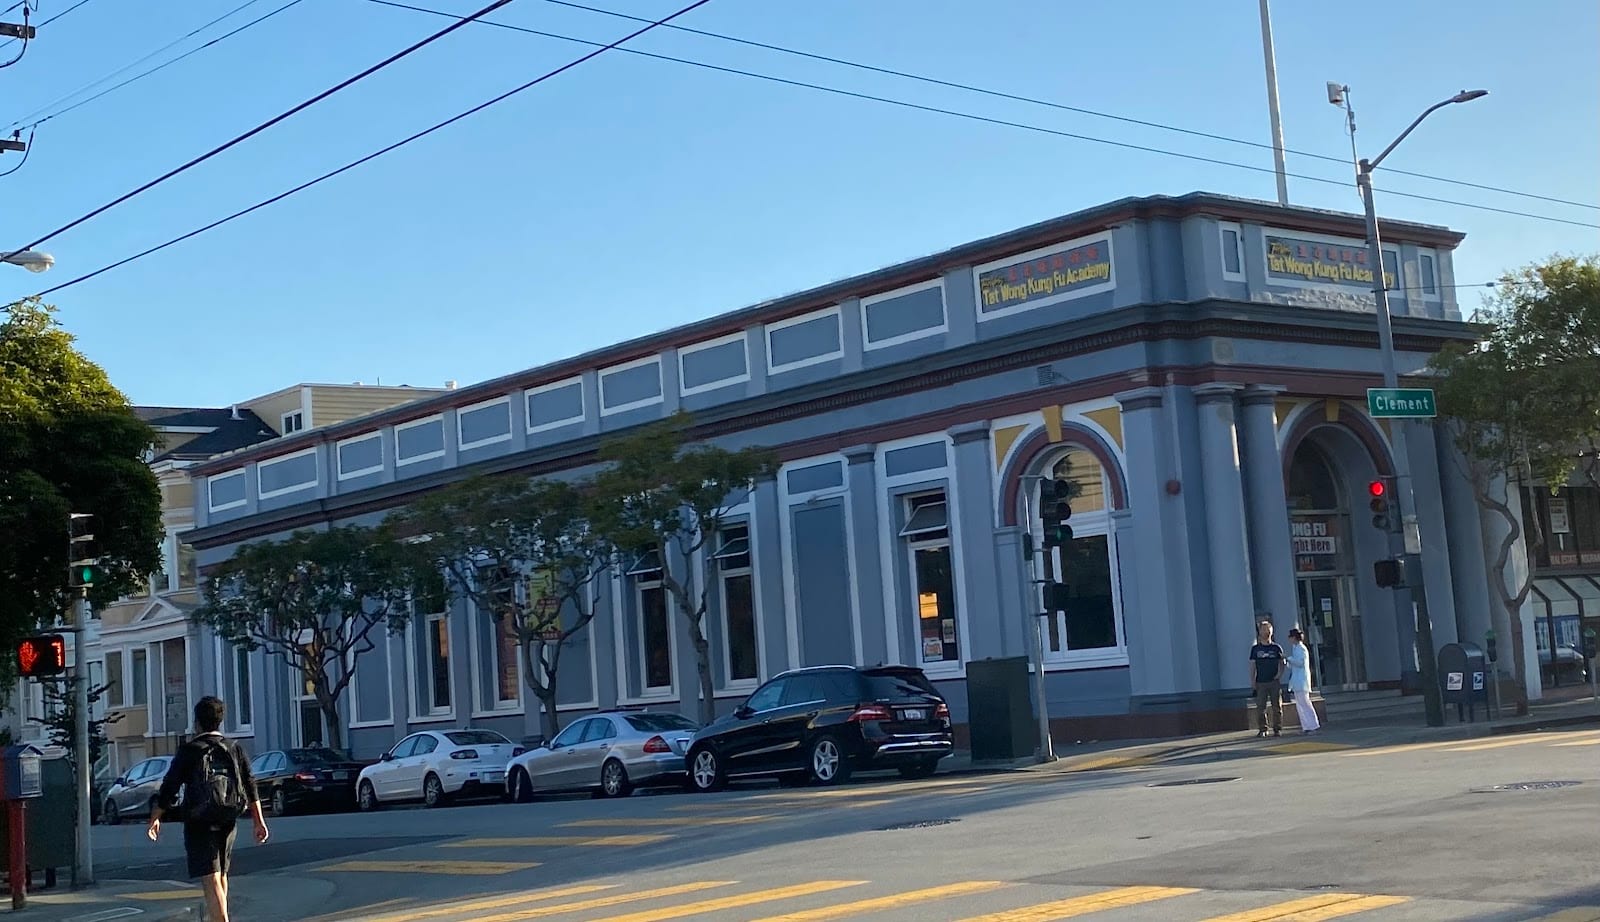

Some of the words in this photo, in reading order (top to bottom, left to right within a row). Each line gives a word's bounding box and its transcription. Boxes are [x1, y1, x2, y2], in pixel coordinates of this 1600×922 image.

[1268, 254, 1285, 272] Tat
[1282, 254, 1313, 279] Wong
[1313, 260, 1339, 282] Kung
[1339, 262, 1352, 280] Fu
[982, 288, 999, 305] Tat
[1001, 284, 1027, 301] Wong
[1027, 277, 1053, 294] Kung
[1053, 270, 1066, 288] Fu
[1066, 262, 1109, 285] Academy
[1375, 396, 1429, 410] Clement
[1312, 522, 1327, 536] FU
[1310, 539, 1331, 552] Here
[51, 642, 62, 666] 7
